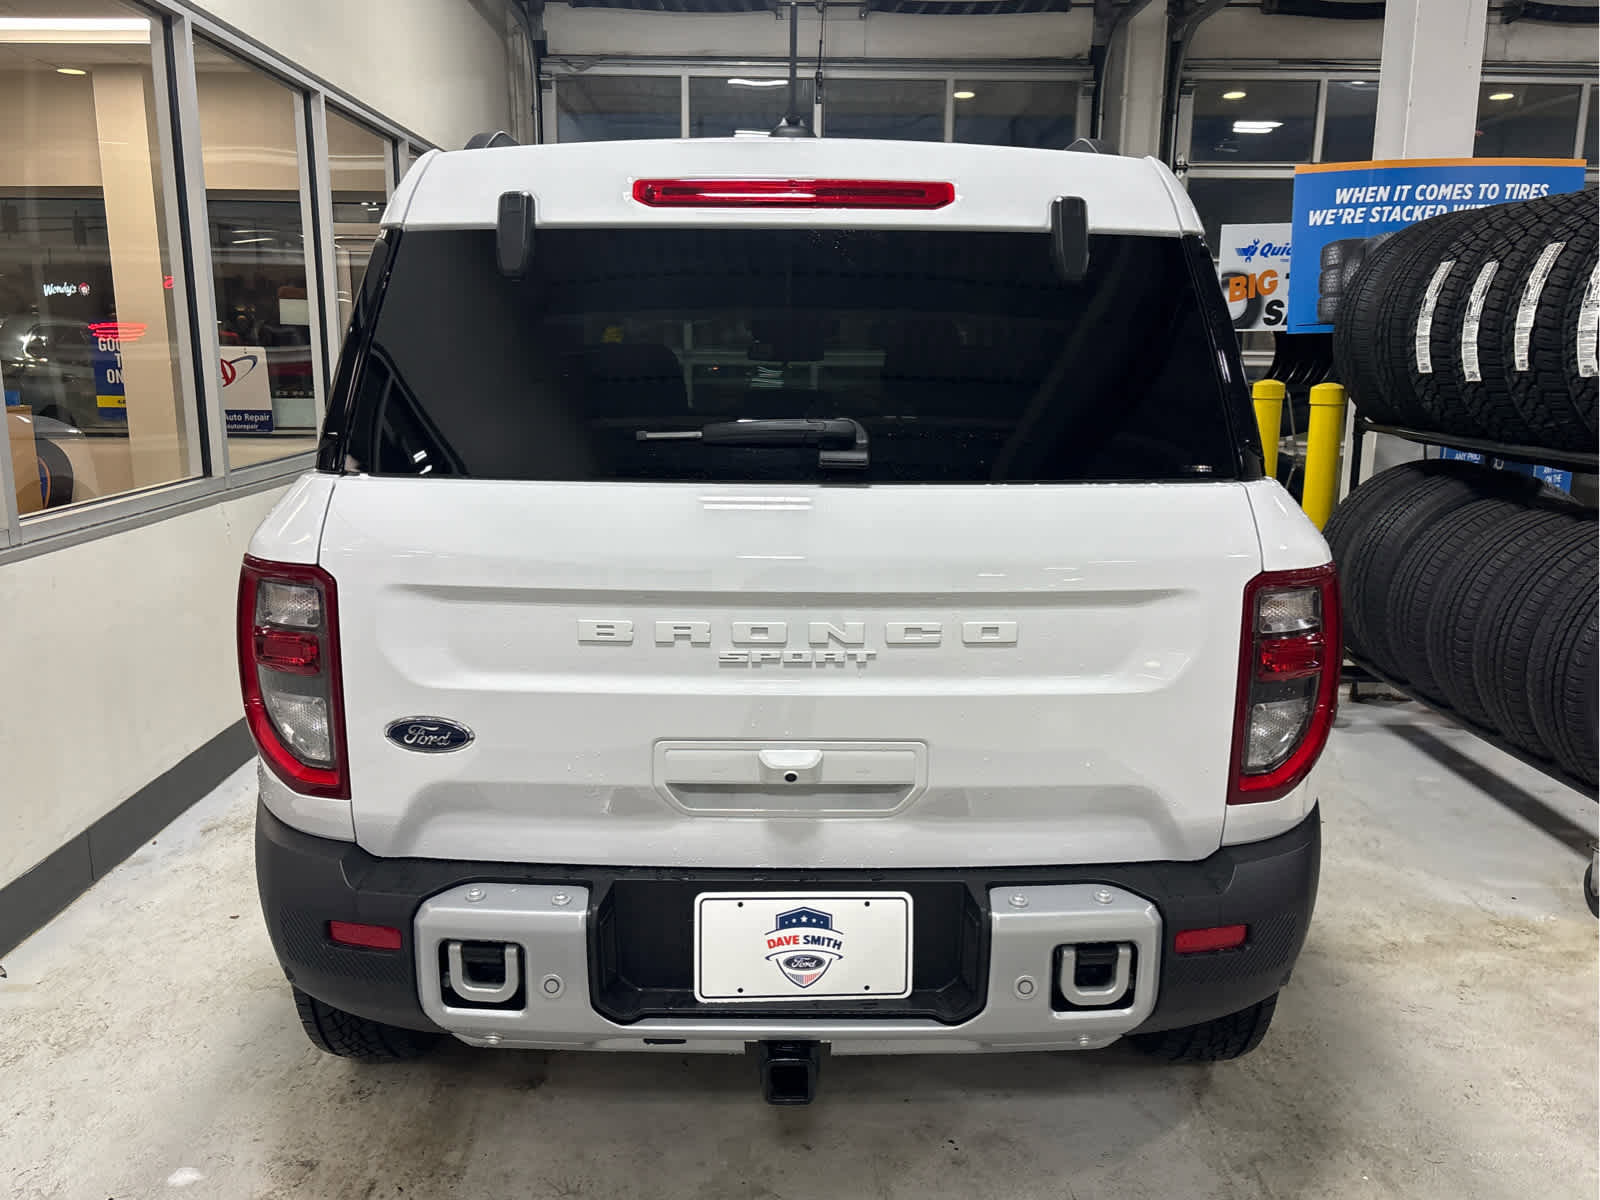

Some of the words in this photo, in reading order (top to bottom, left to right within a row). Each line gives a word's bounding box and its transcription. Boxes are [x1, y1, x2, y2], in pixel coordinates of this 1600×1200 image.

[1335, 185, 1390, 205] WHEN
[1393, 184, 1411, 202] IT
[1415, 183, 1474, 201] COMES
[1478, 183, 1500, 200] TO
[1505, 183, 1550, 200] TIRES
[1308, 207, 1366, 226] WE'RE
[43, 281, 77, 297] Wendy's
[1229, 269, 1279, 303] BIG
[244, 412, 270, 422] Repair
[578, 619, 1019, 647] BRONCO
[719, 650, 876, 669] SPORT
[402, 724, 451, 749] Ford
[767, 934, 800, 949] DAVE
[803, 934, 843, 950] SMITH
[791, 957, 817, 968] Ford
